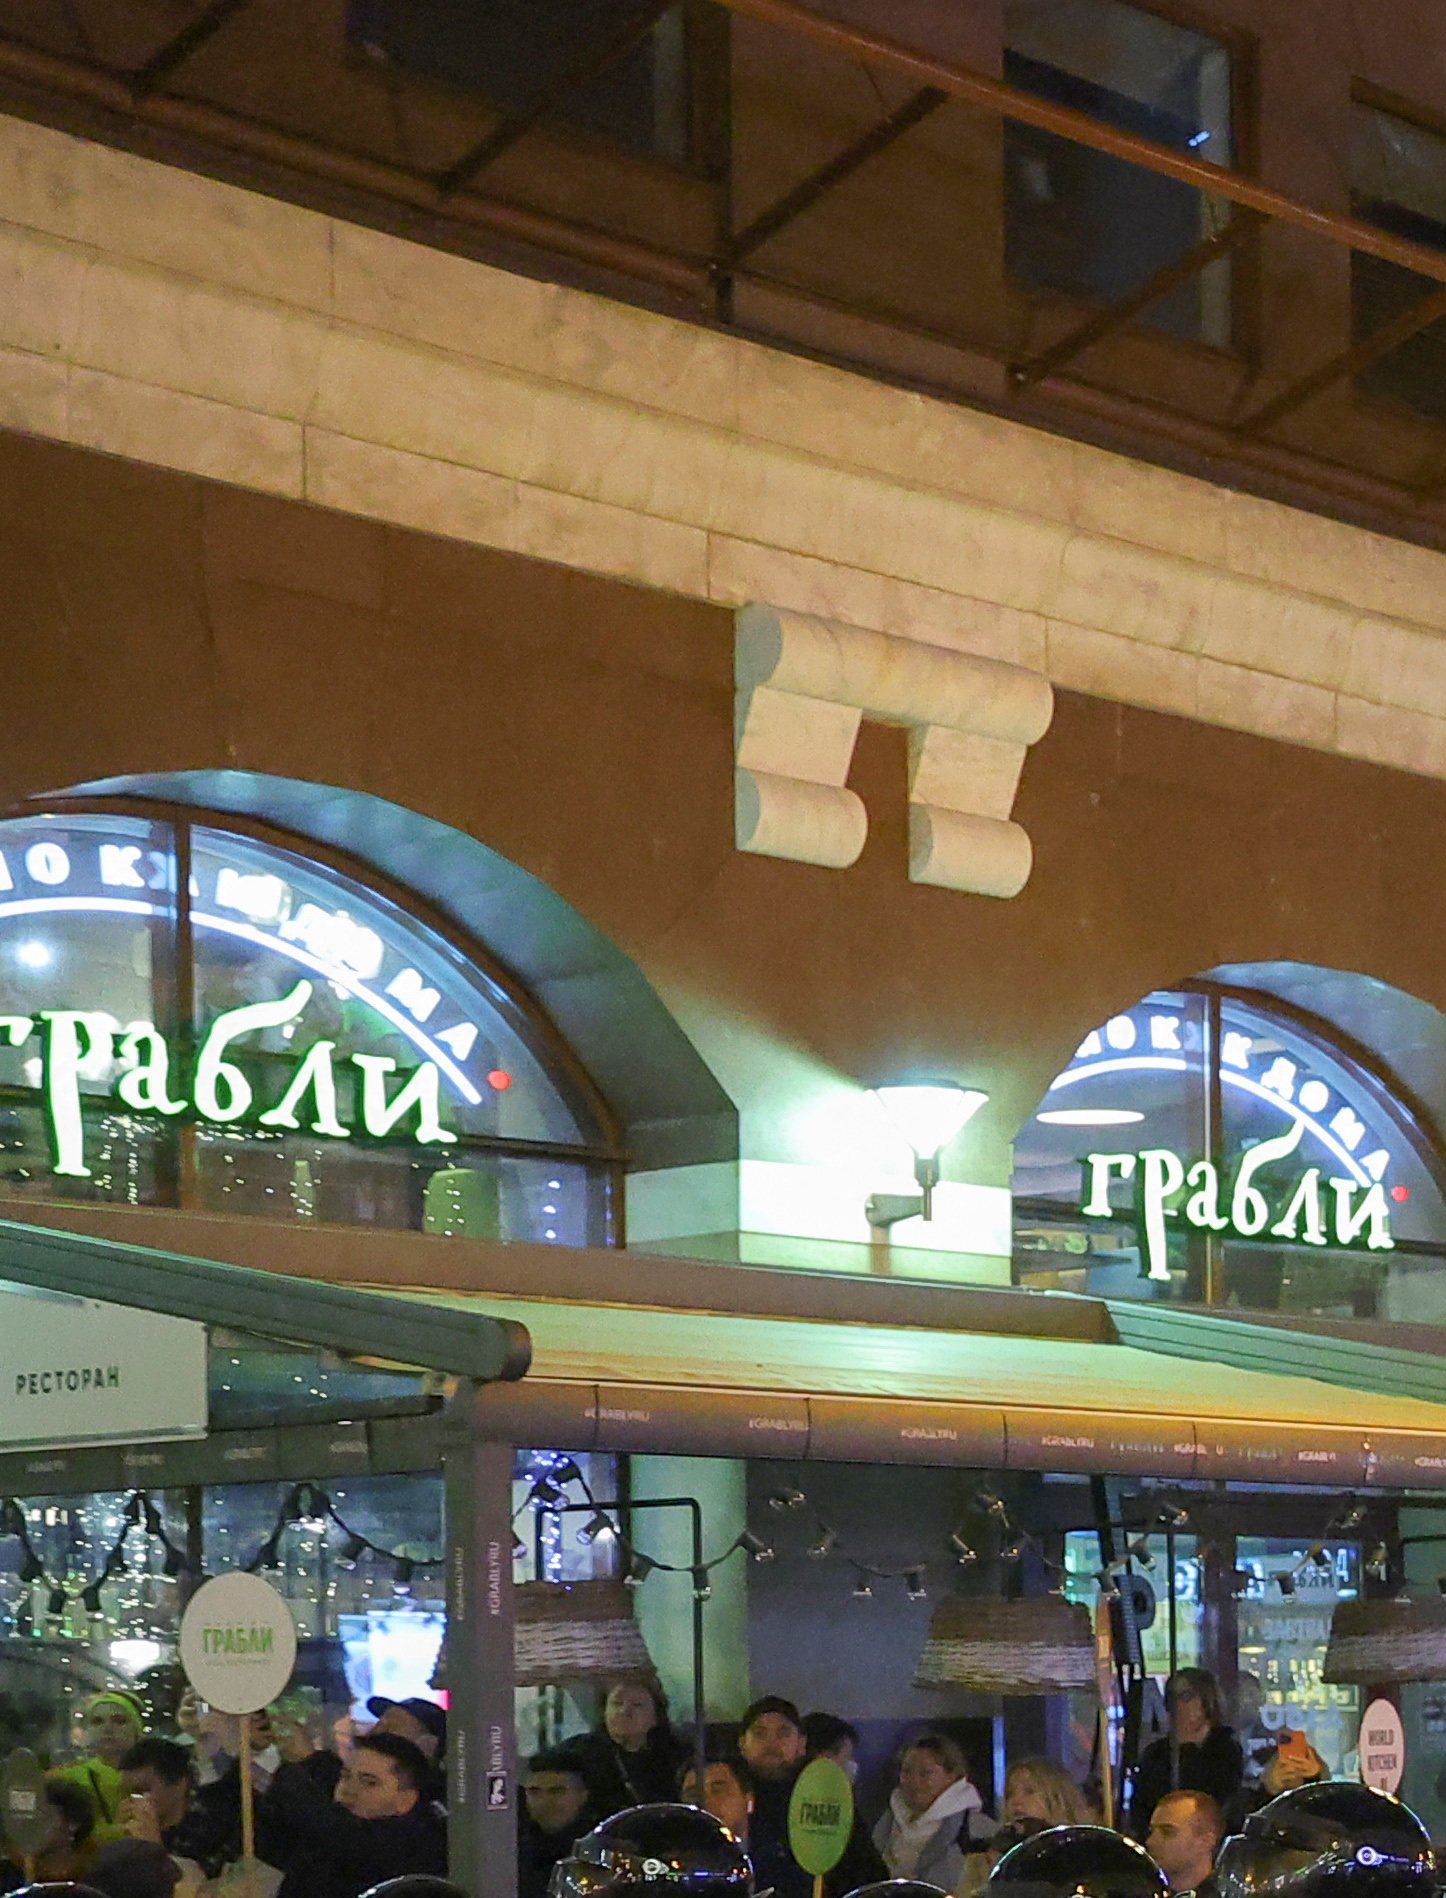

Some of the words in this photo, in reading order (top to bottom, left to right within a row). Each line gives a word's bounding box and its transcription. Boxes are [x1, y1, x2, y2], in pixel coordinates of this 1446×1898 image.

[16, 1366, 119, 1394] РЕСТОРАН
[202, 1628, 274, 1653] ГРАБЛИ
[1368, 1729, 1394, 1746] WORLD
